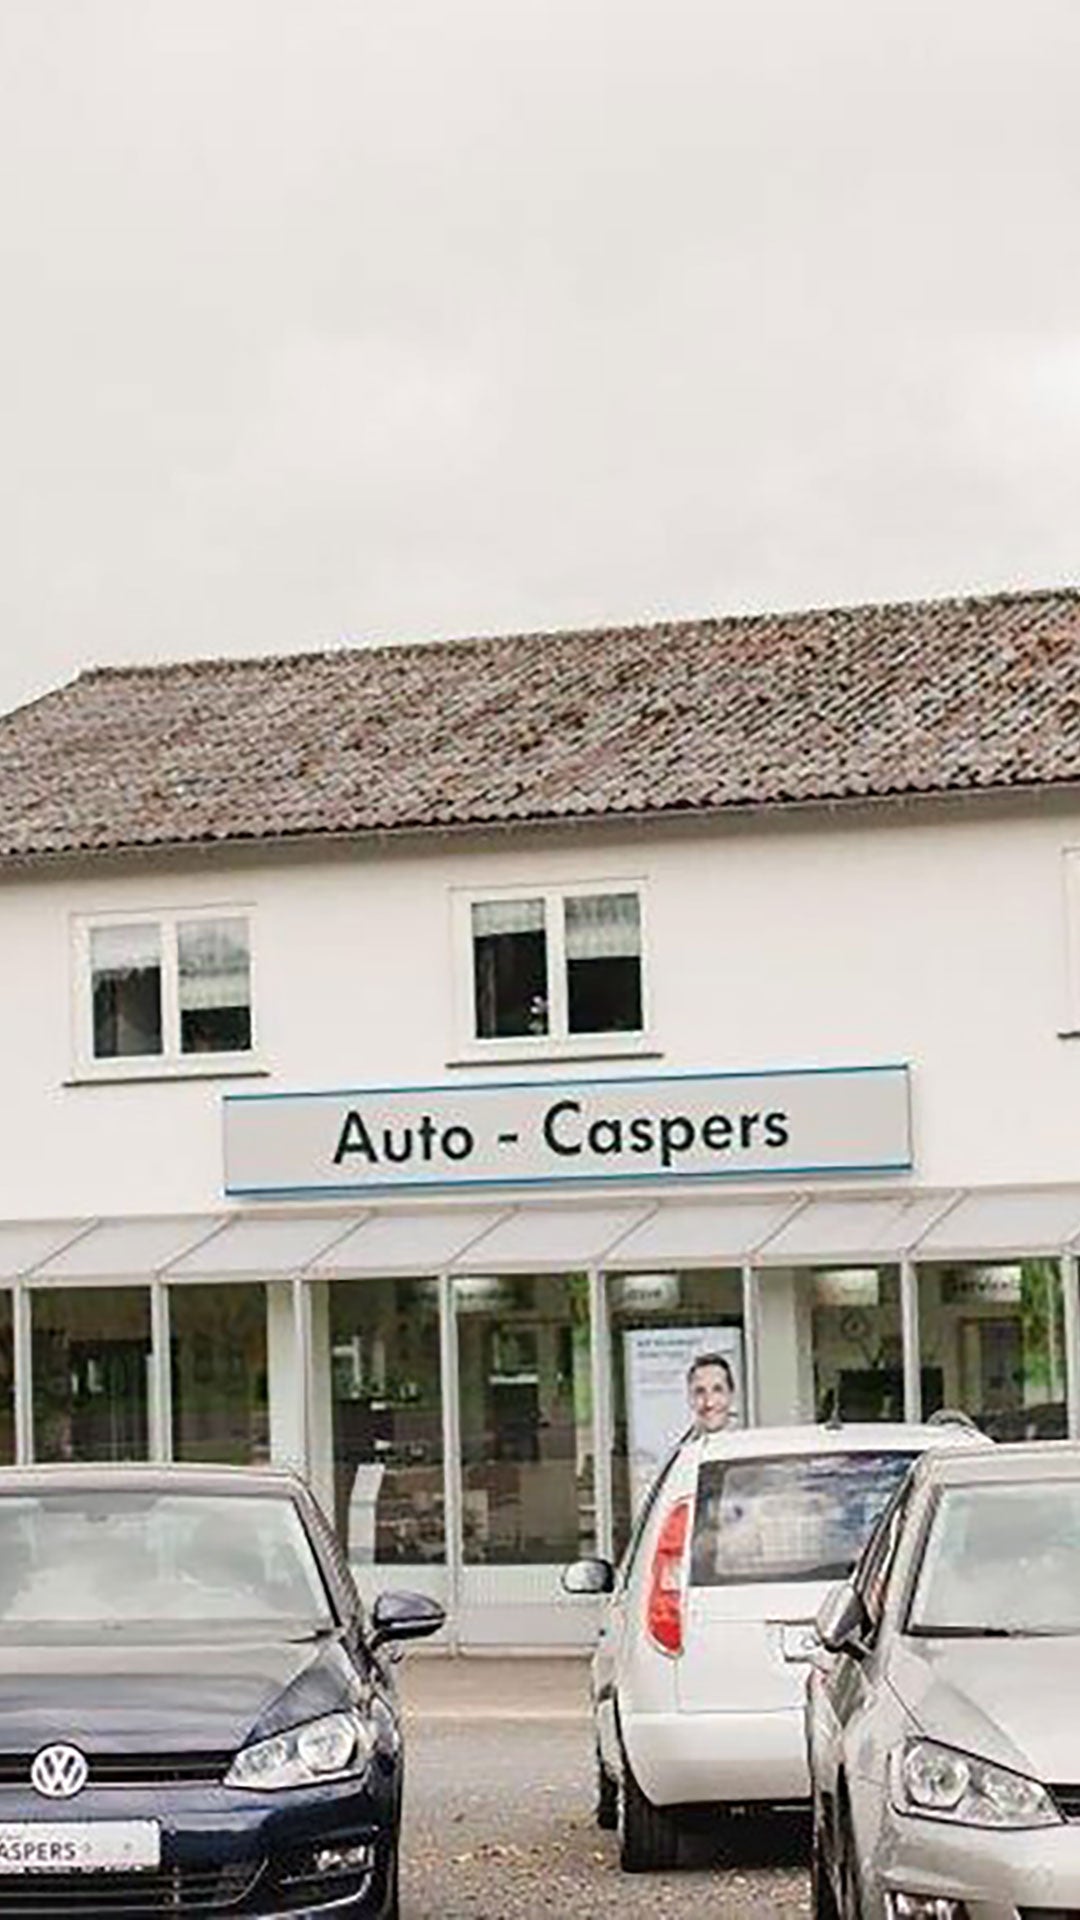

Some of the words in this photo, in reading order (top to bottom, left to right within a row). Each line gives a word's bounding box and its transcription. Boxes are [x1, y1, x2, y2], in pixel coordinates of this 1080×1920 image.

[333, 1110, 474, 1165] Auto
[498, 1133, 518, 1143] -
[543, 1100, 789, 1167] Caspers
